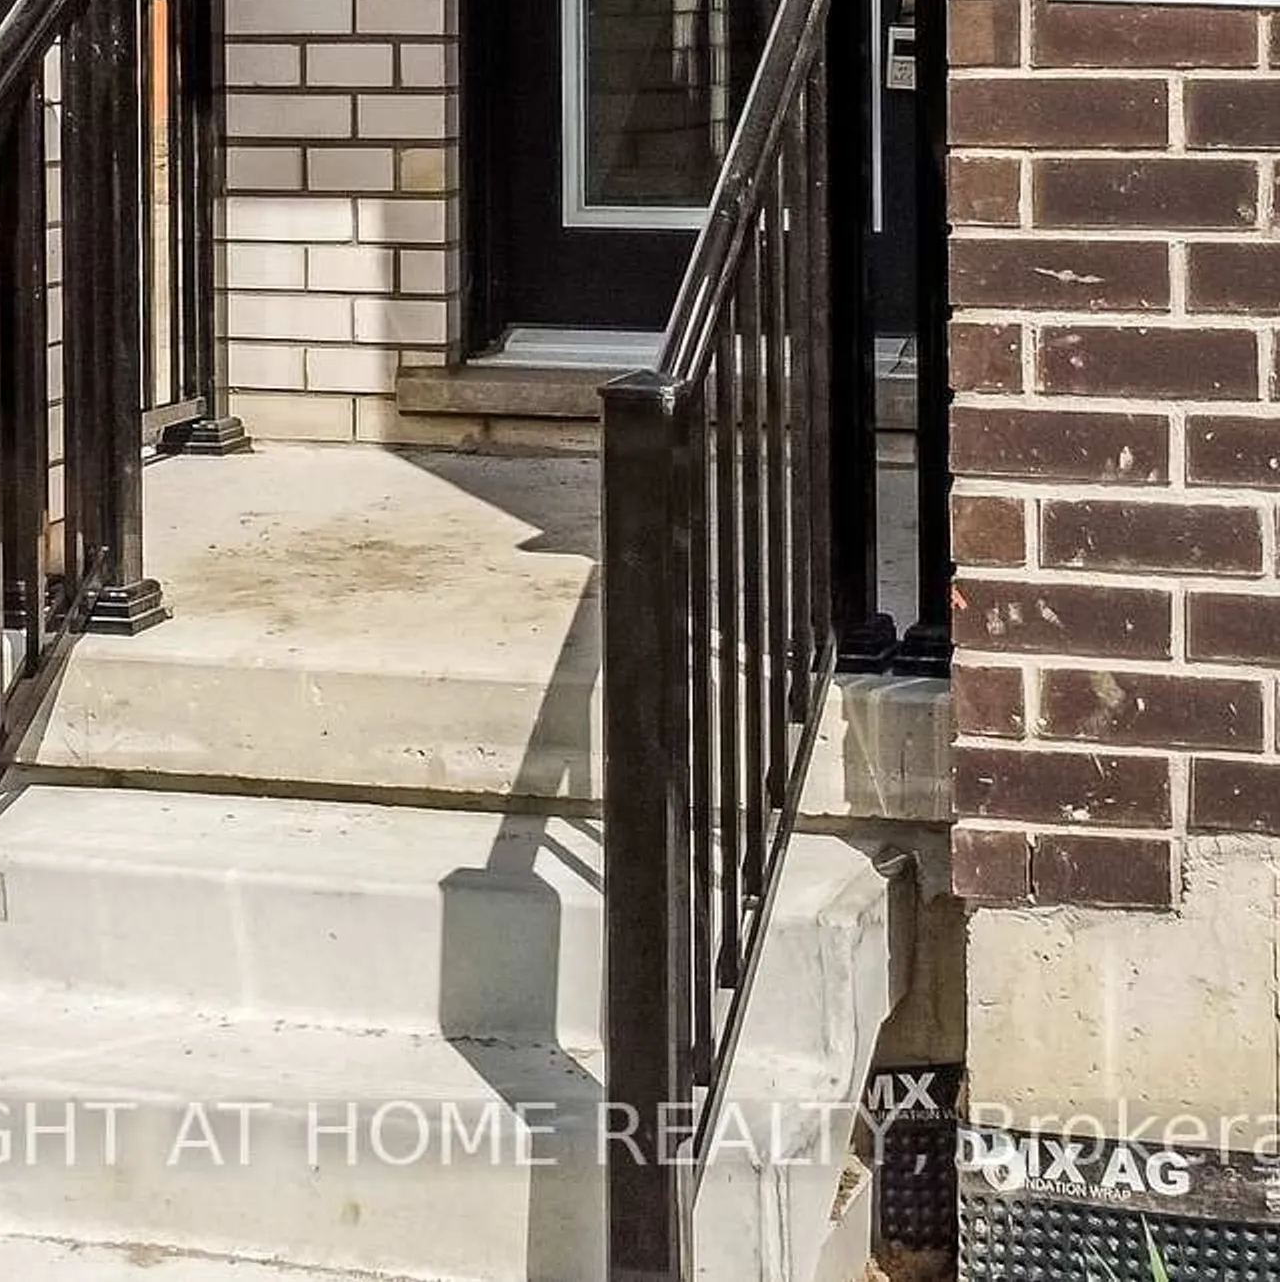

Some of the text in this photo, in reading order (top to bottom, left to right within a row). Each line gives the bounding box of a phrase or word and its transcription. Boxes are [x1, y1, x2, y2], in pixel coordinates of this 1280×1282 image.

[867, 1072, 939, 1110] MX
[1024, 1177, 1087, 1199] NDATION
[1100, 1147, 1190, 1197] AG
